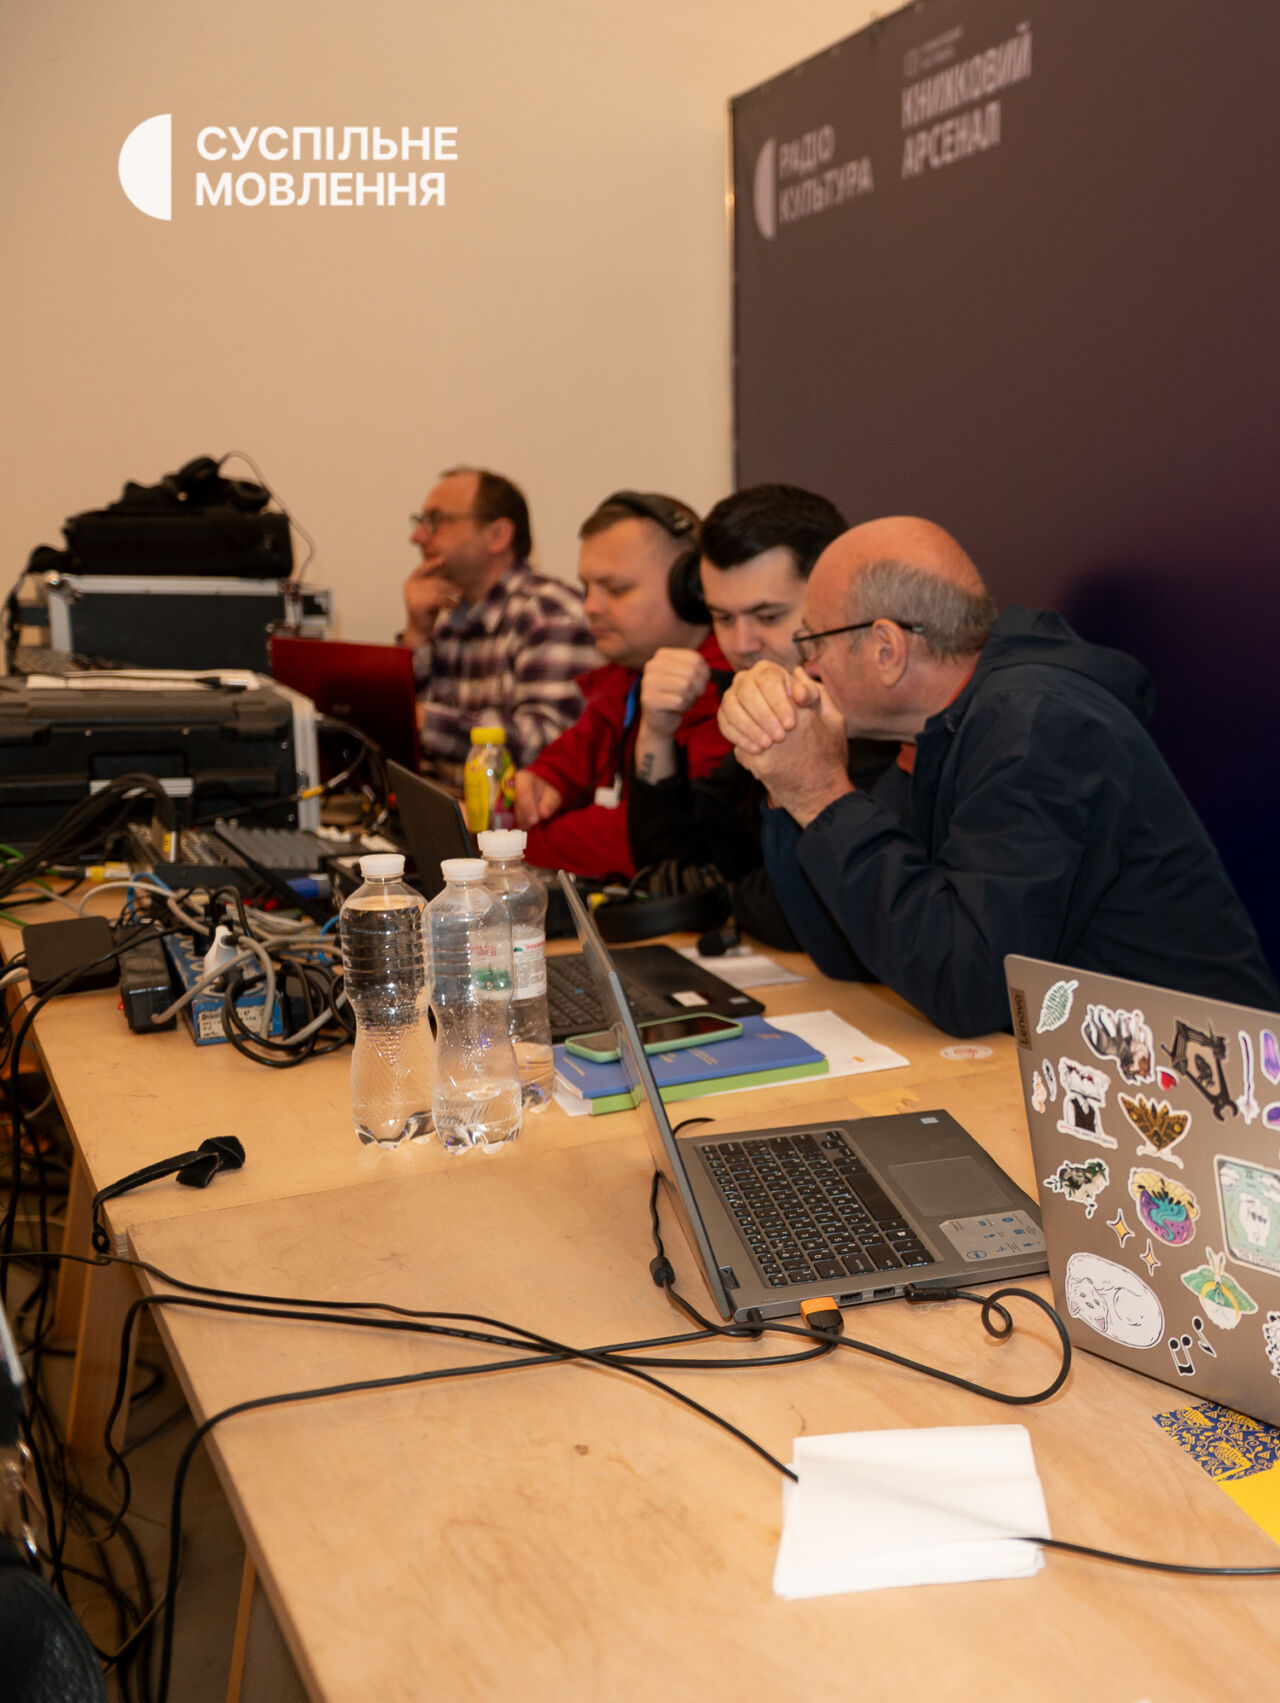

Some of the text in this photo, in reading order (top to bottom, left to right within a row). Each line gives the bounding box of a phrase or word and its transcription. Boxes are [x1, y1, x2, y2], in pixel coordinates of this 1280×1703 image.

[902, 20, 1032, 129] КНИЖКОВИЙ
[779, 124, 836, 180] РАДІО
[902, 100, 1000, 179] АРСЕНАЛ
[779, 155, 874, 224] КУЛЬТУРА
